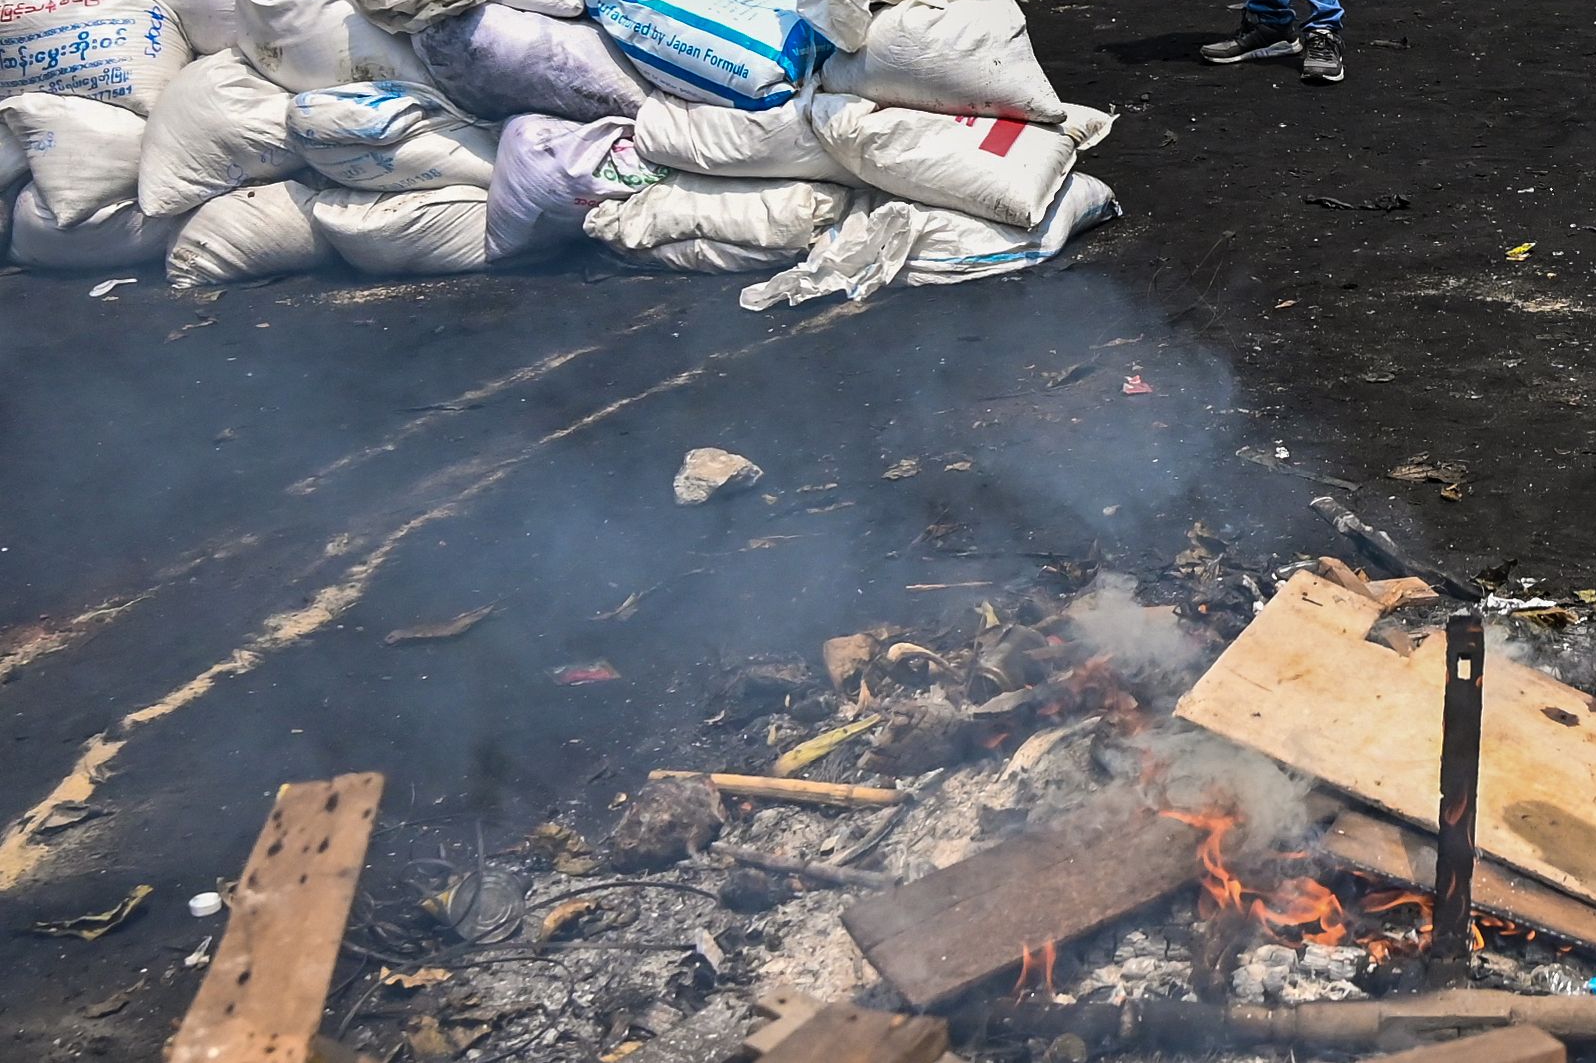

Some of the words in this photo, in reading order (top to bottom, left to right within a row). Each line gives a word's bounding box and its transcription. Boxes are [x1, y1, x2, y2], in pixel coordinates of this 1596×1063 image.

[650, 25, 665, 46] by
[666, 34, 701, 60] Japan
[703, 47, 750, 80] Formula
